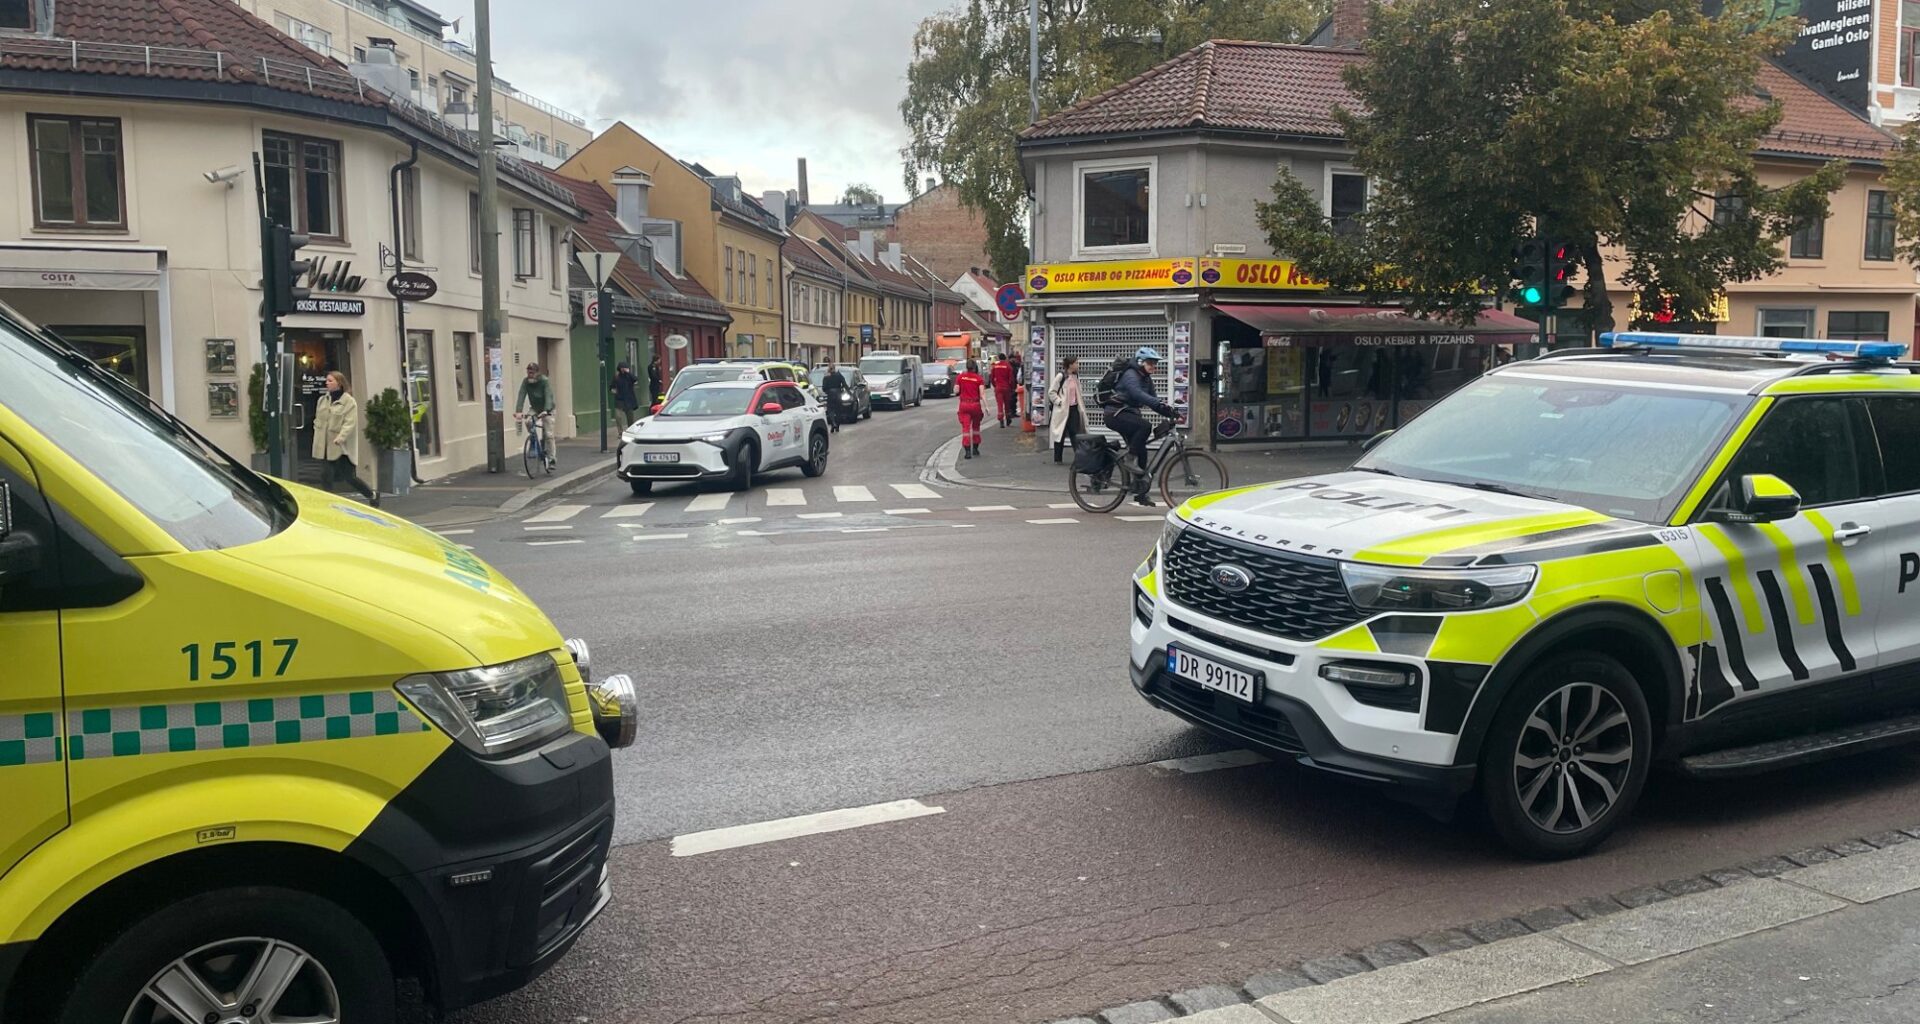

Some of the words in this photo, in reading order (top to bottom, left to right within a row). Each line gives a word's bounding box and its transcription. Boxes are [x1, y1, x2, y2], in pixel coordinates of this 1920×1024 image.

[1798, 13, 1870, 37] ivatMegleren
[1811, 34, 1844, 50] Gamle
[1846, 29, 1869, 43] Oslo
[41, 273, 75, 281] COSTA
[1054, 273, 1075, 283] OSLO
[1078, 271, 1107, 282] KEBAB
[1110, 270, 1121, 280] OG
[1125, 268, 1171, 280] PIZZAHUS
[1236, 264, 1281, 284] OSLO
[297, 301, 318, 312] RKISK
[319, 301, 362, 313] RESTAURANT
[591, 307, 598, 317] 3
[1354, 335, 1381, 346] OSLO
[1385, 335, 1416, 345] KEBAB
[1420, 335, 1425, 344] &
[1430, 334, 1474, 345] PIZZAHUS
[1193, 516, 1344, 556] EXPLORER
[1659, 530, 1688, 542] 6315
[181, 638, 299, 681] 1517
[1180, 654, 1199, 679] DR
[1206, 663, 1248, 697] 99112
